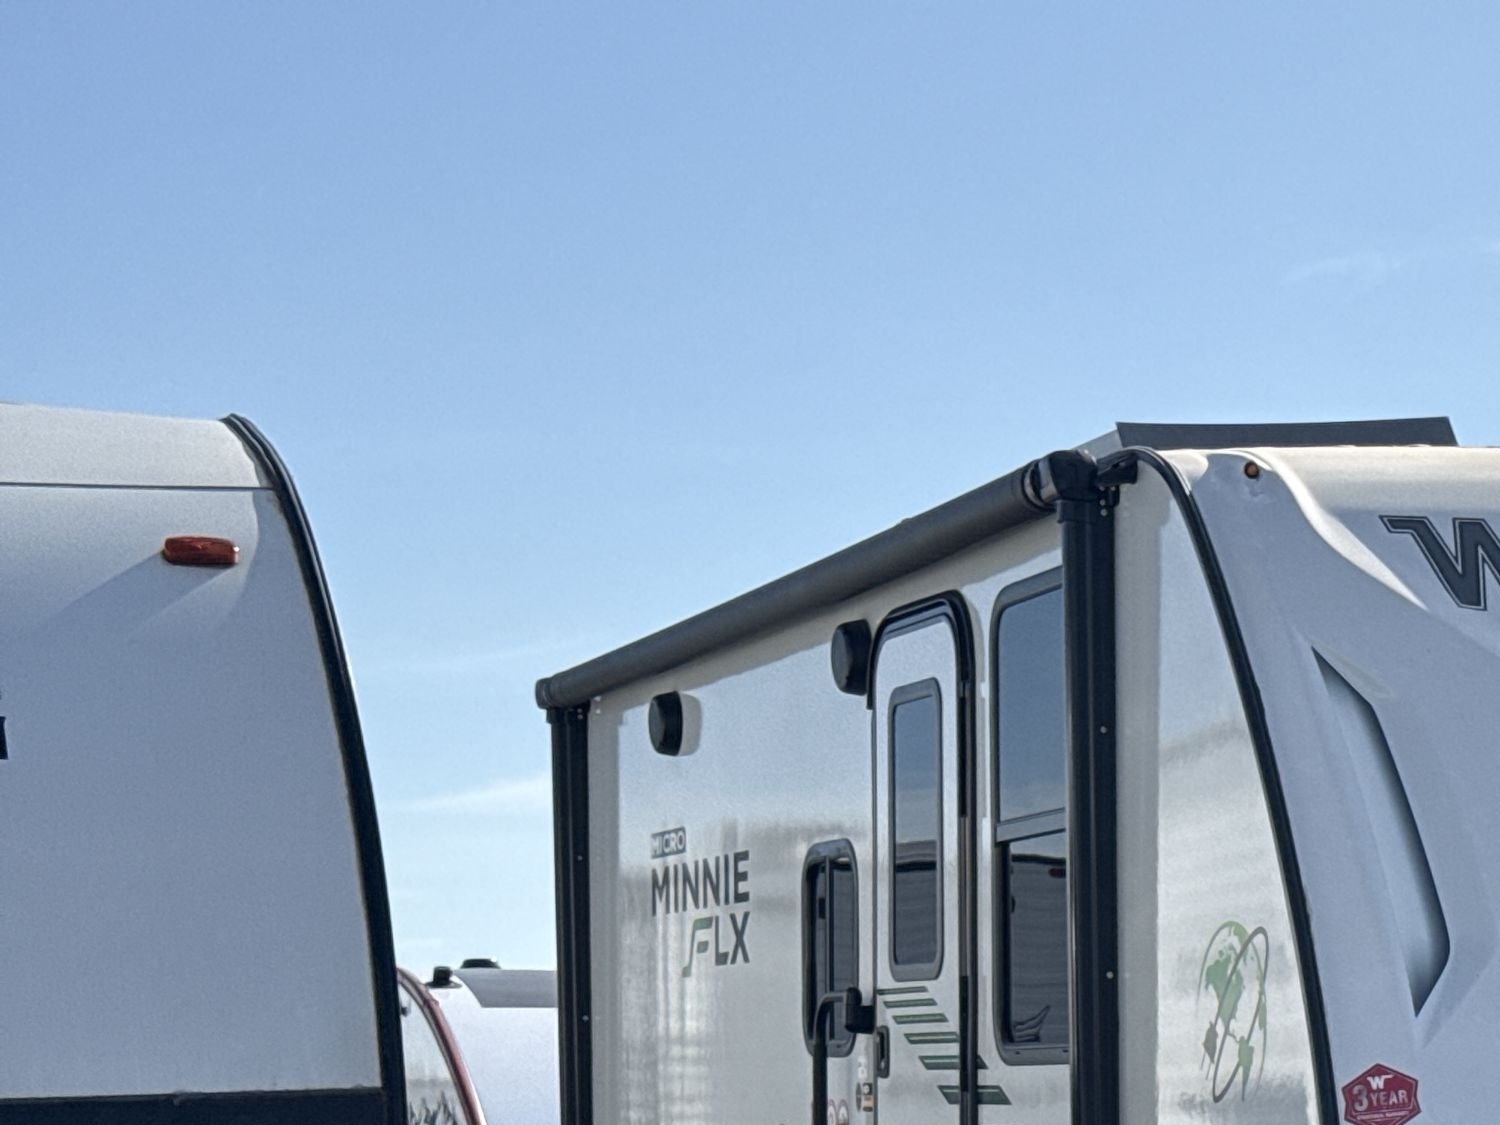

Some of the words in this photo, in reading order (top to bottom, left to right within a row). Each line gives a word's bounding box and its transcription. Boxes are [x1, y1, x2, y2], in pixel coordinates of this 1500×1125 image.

[652, 850, 750, 917] MINNIE
[682, 911, 750, 978] FLX
[1353, 1085, 1369, 1111] 3
[1370, 1090, 1409, 1107] YEAR
